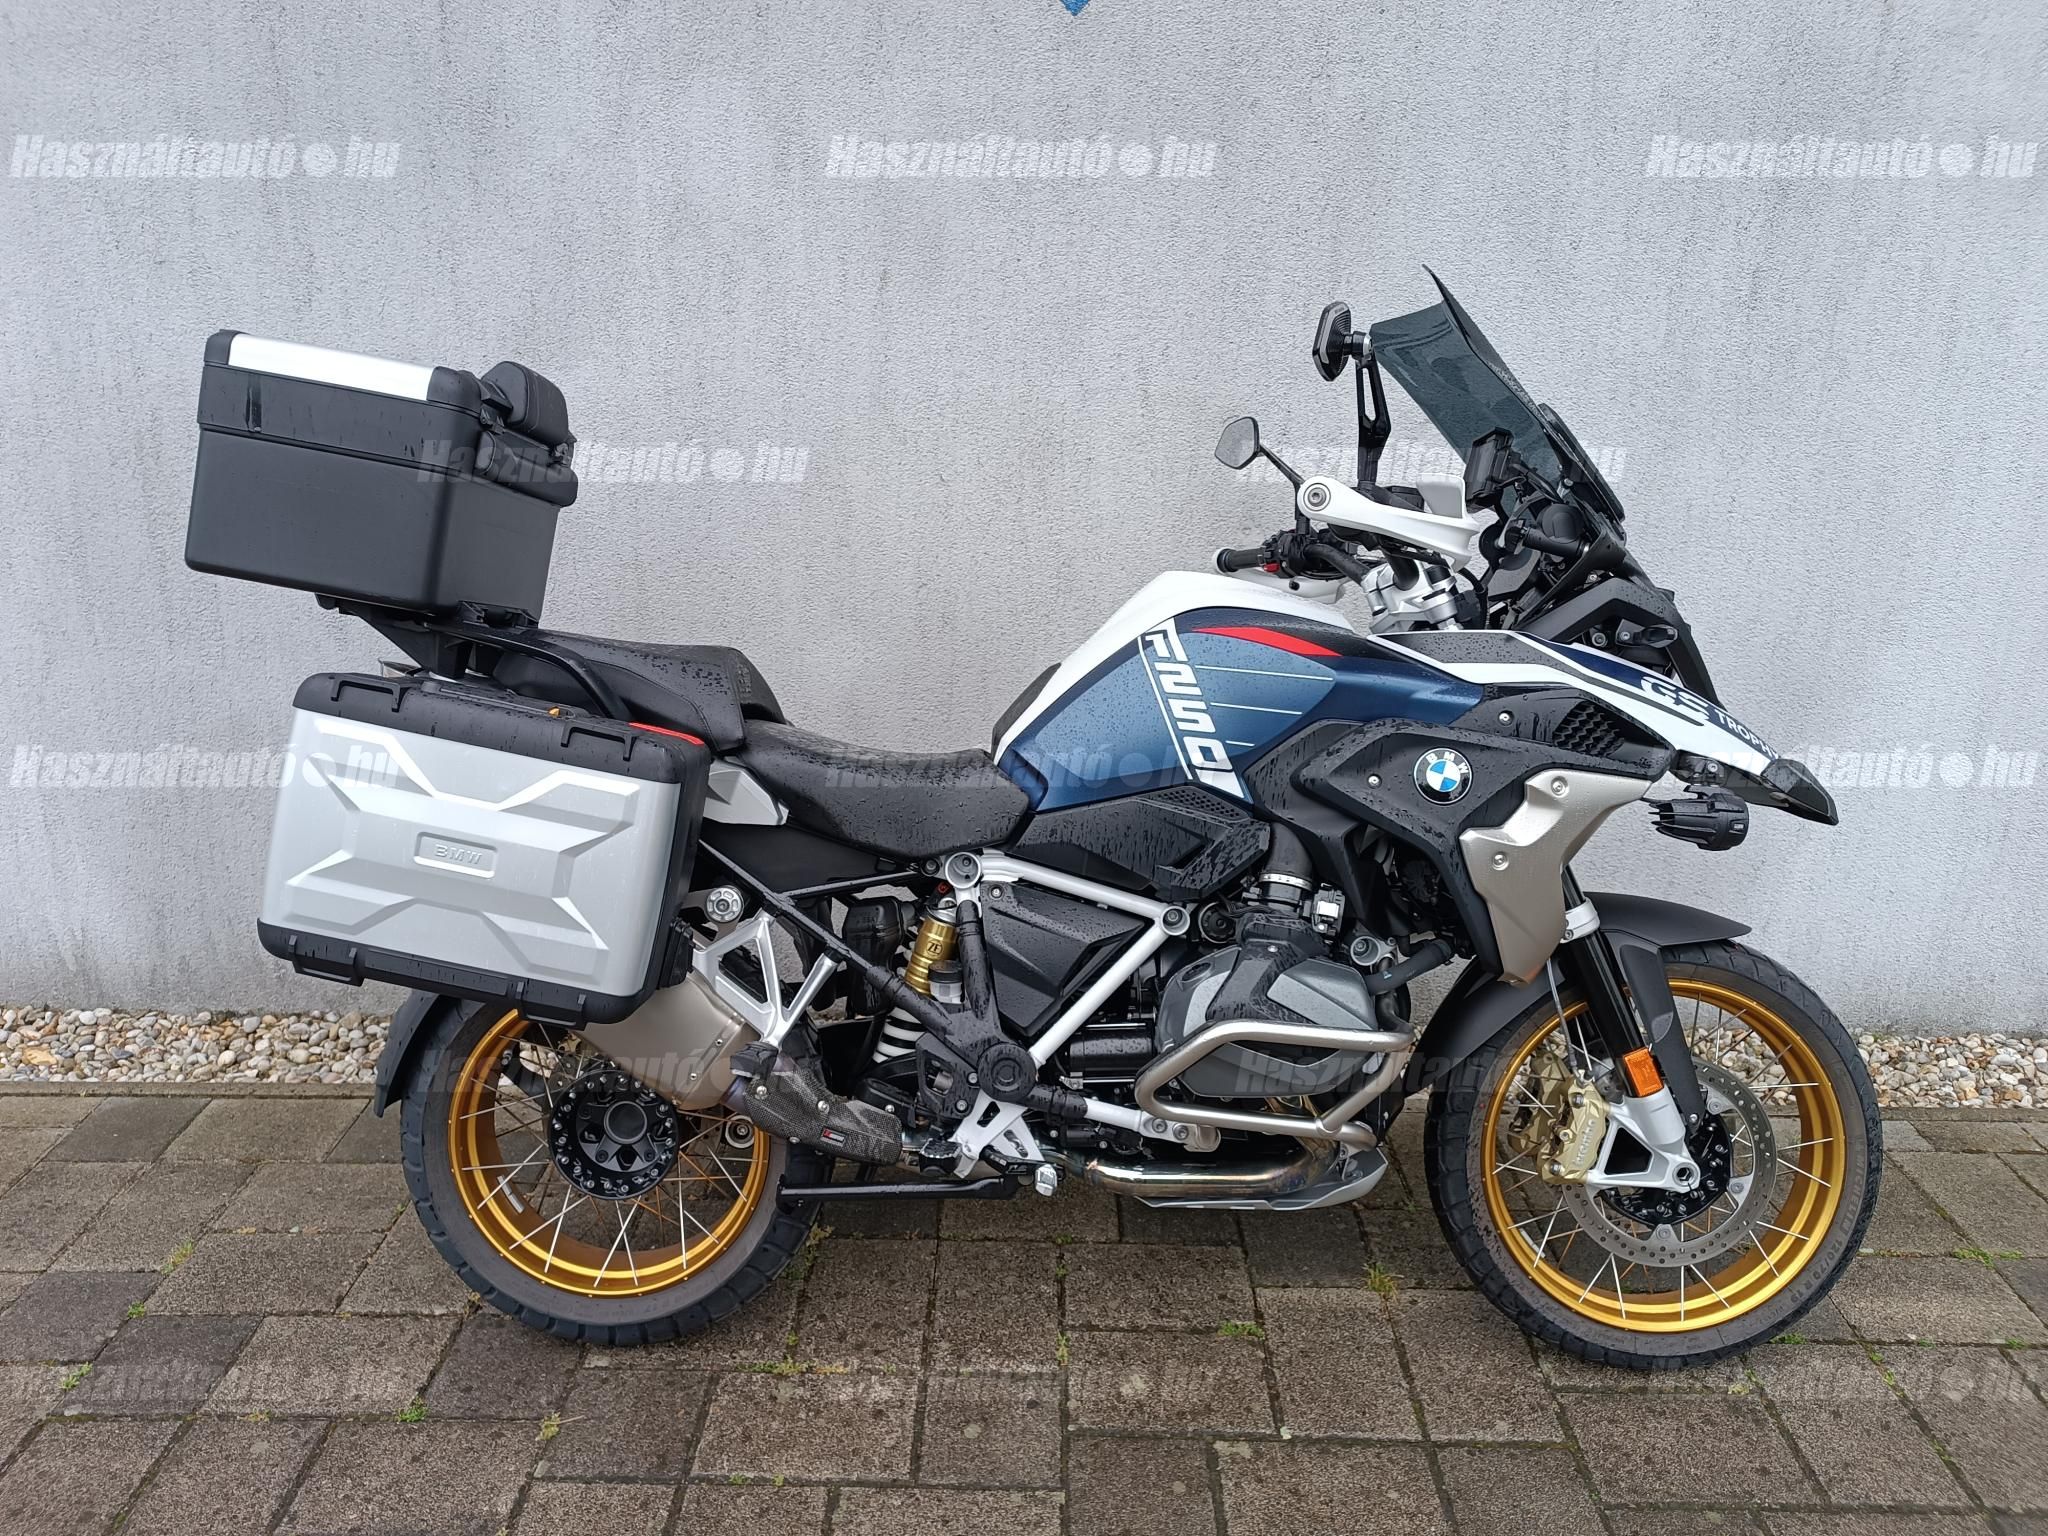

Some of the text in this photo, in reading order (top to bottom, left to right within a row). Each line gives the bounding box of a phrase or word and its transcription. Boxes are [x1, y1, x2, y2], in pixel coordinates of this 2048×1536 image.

[1641, 676, 1709, 722] GS
[434, 843, 483, 865] BMW
[928, 942, 943, 955] ZF
